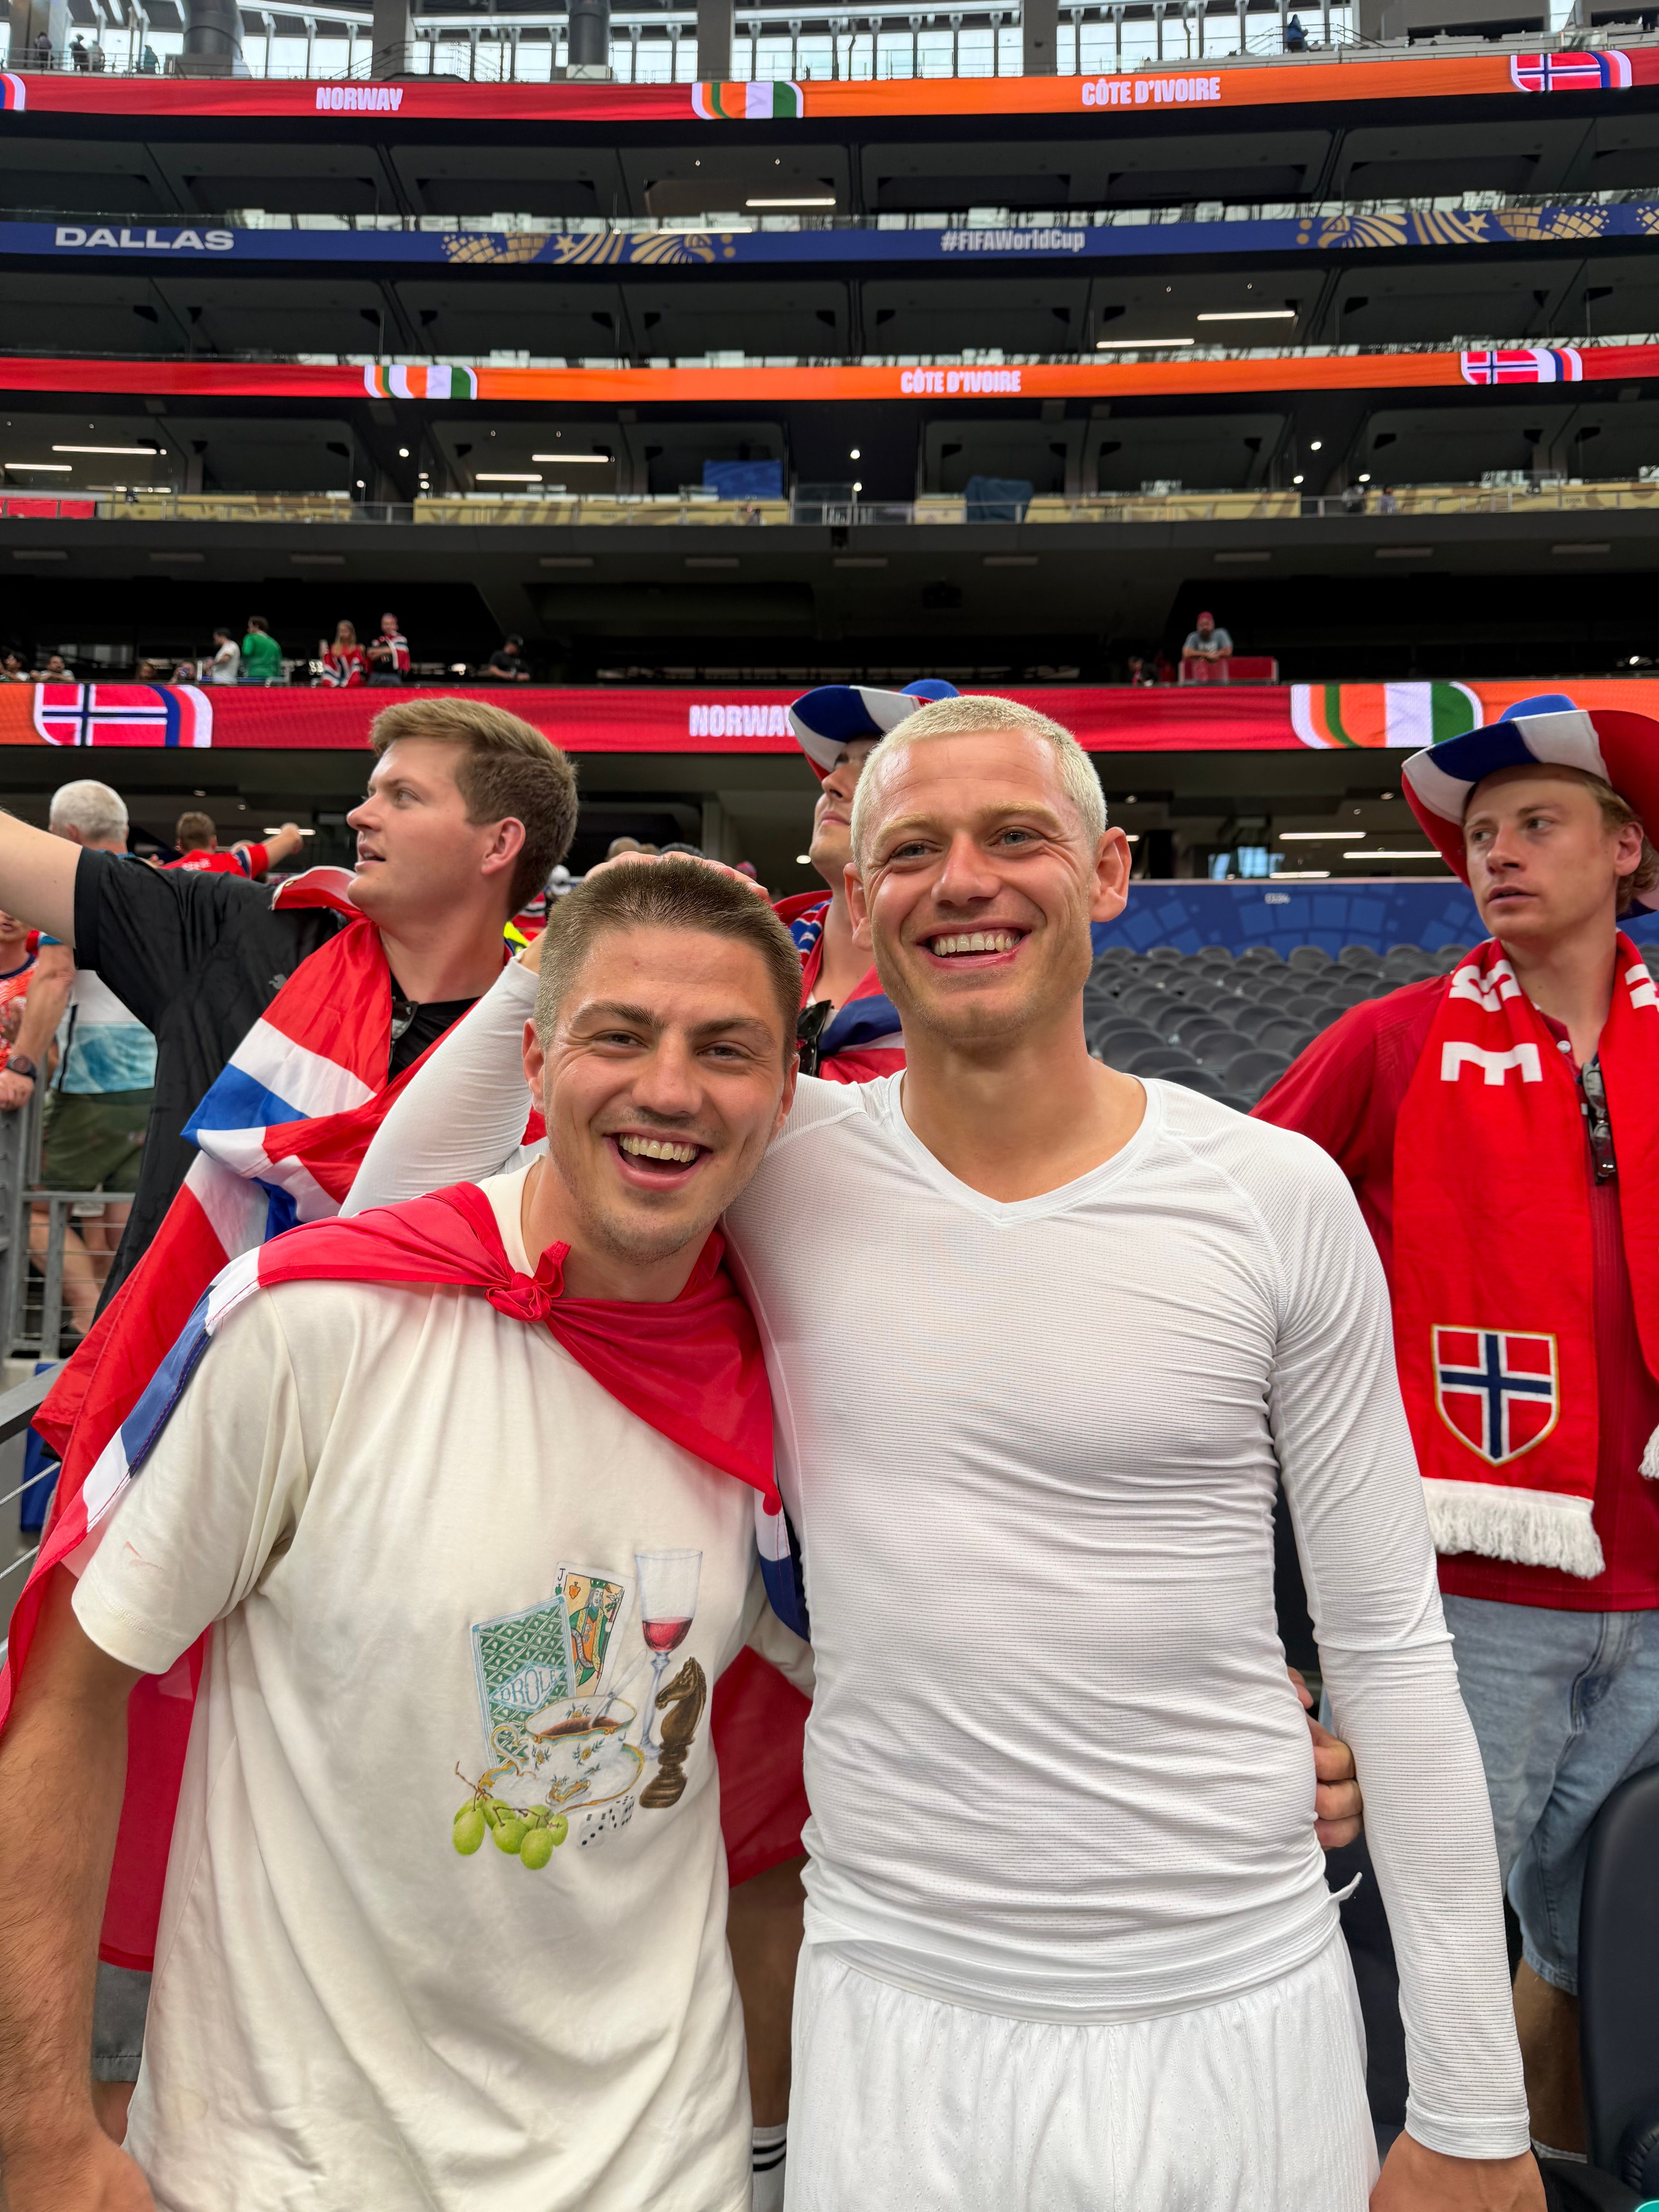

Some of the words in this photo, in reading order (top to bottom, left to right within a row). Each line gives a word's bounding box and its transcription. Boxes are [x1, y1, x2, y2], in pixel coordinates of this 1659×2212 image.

[316, 87, 403, 110] NORWAY
[1082, 79, 1132, 105] CÔTE
[1135, 77, 1221, 103] D'IVOIRE
[55, 227, 234, 251] DALLAS
[940, 229, 1085, 252] #FIFAWorldCup
[901, 367, 945, 393] CÔTE
[946, 371, 1021, 393] D'IVOIRE
[558, 1568, 565, 1581] J
